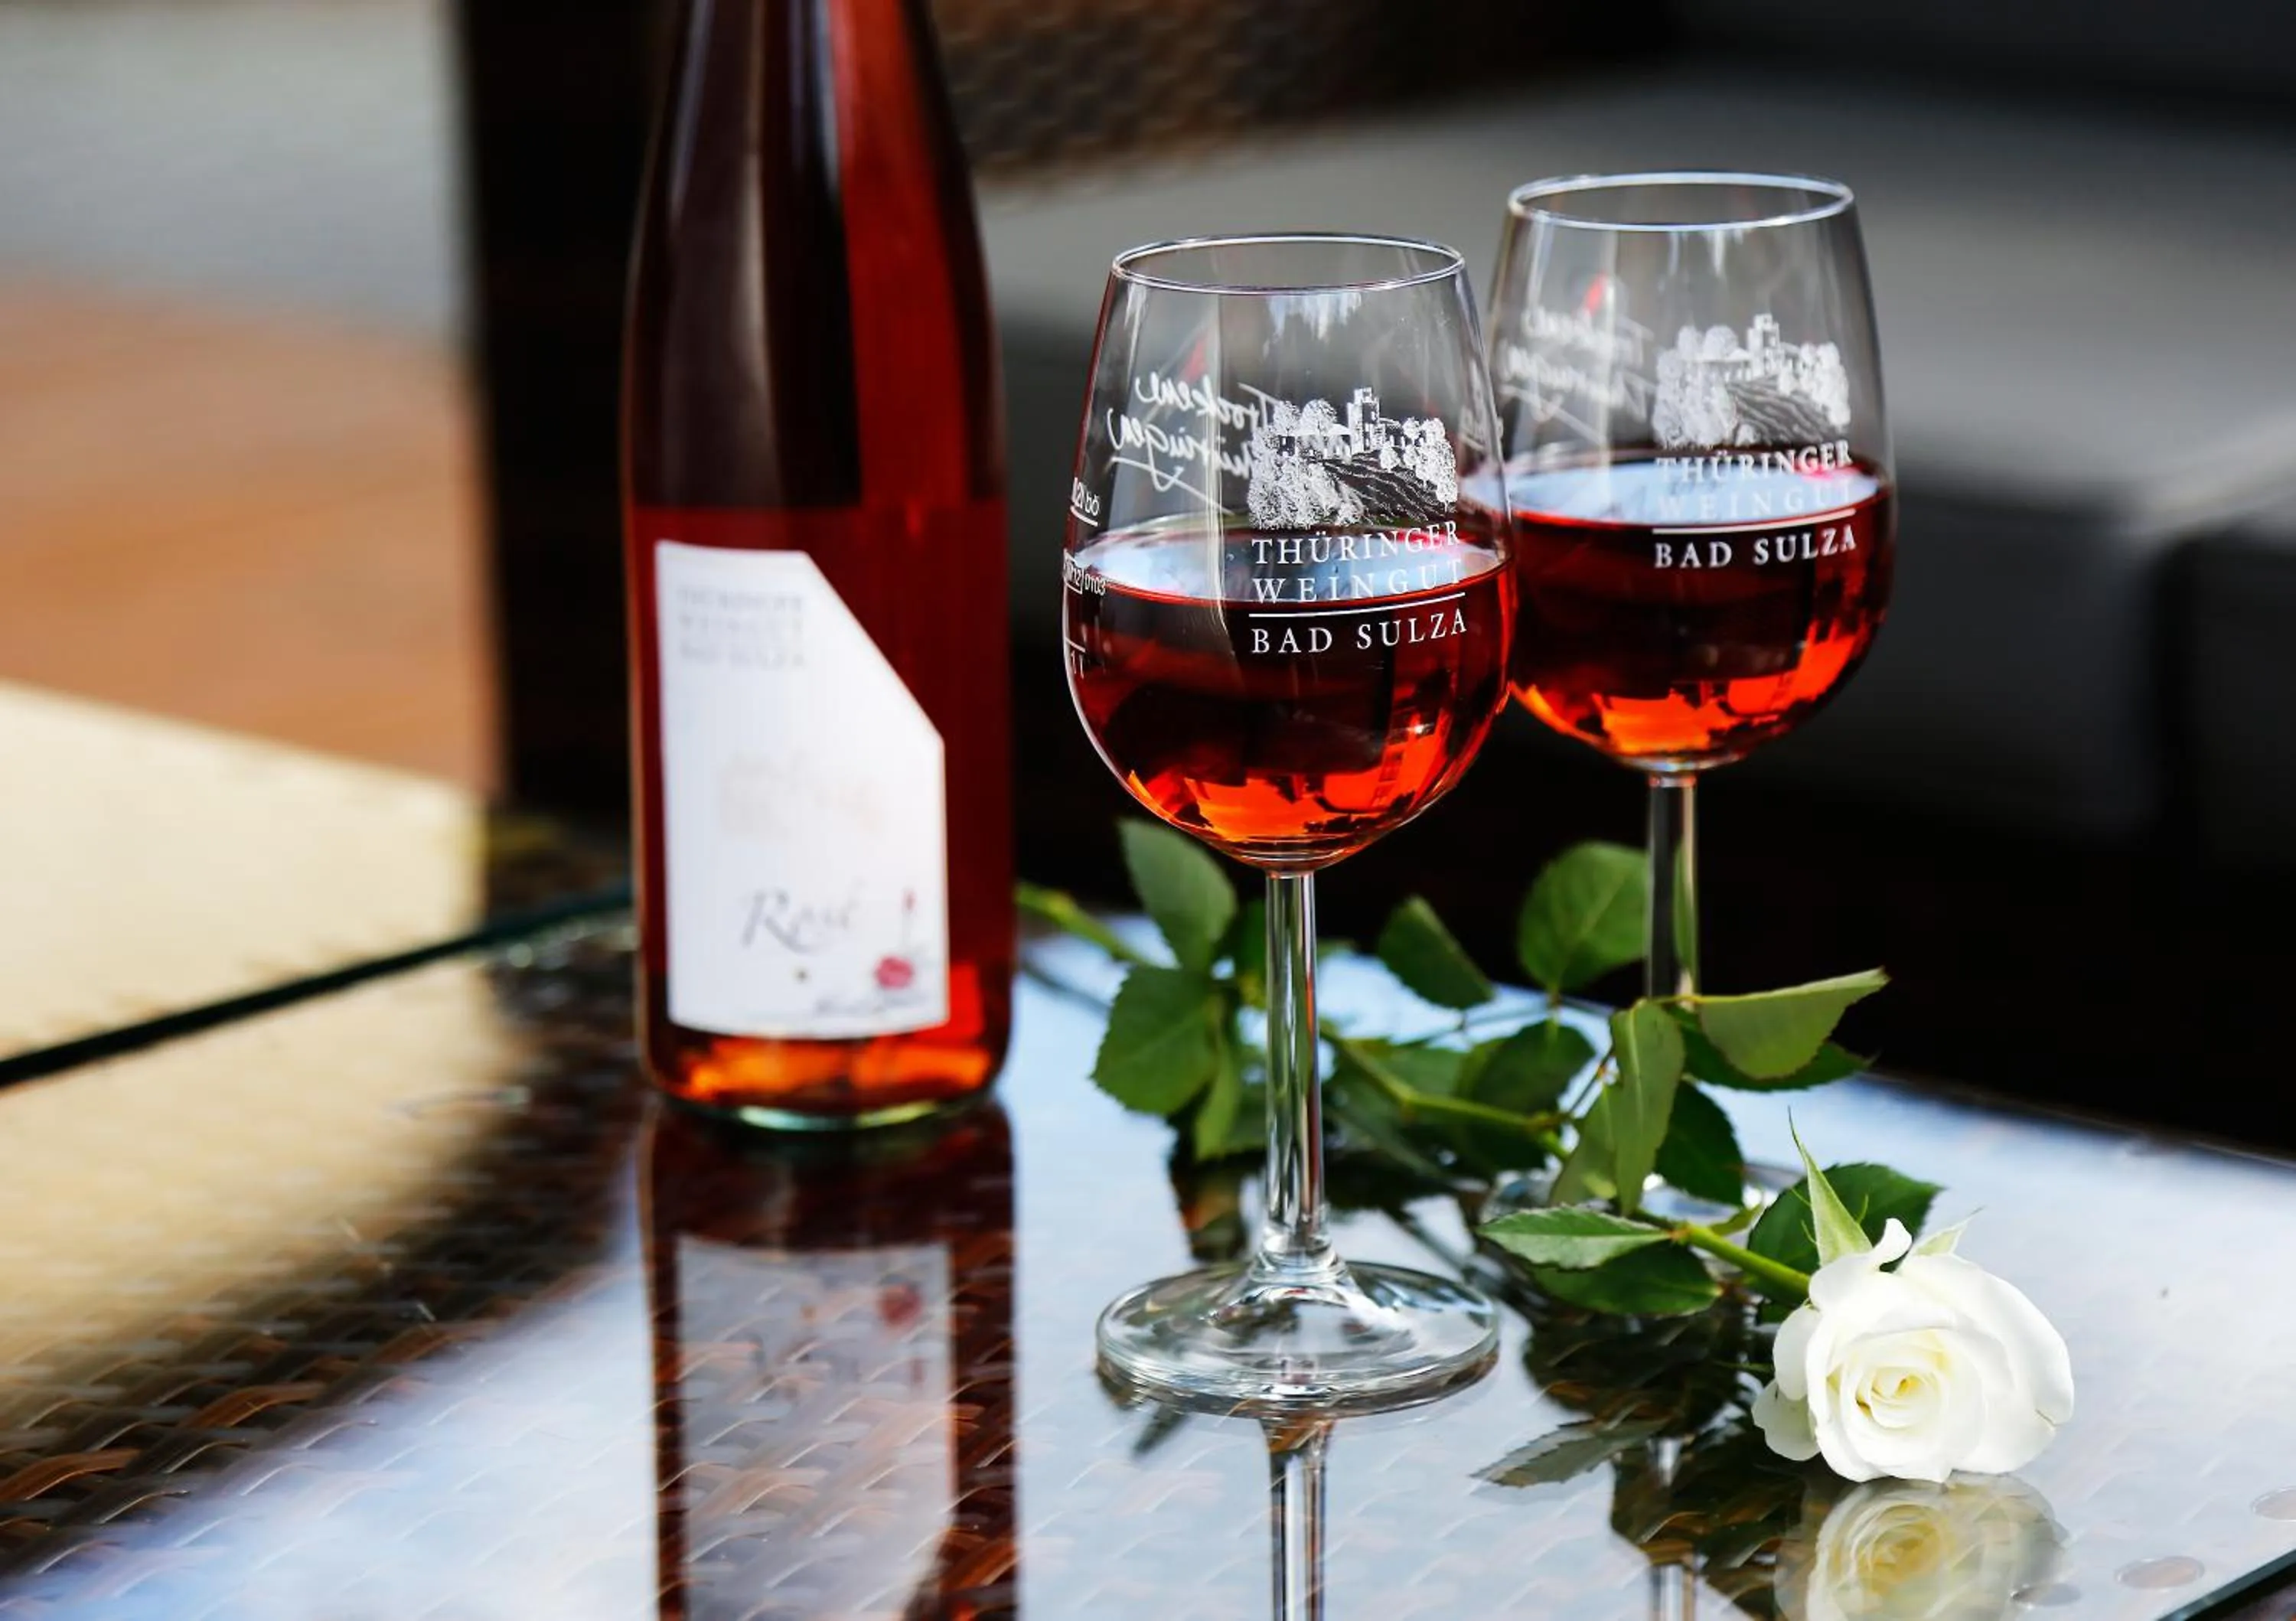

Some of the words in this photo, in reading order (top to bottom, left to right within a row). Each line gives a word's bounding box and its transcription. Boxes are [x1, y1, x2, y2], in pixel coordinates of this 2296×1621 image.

[1655, 439, 1853, 484] THÜRINGER
[1656, 478, 1851, 520] WEINGUT
[1251, 520, 1459, 564] THÜRINGER
[1654, 540, 1733, 569] BAD
[1754, 524, 1857, 565] SULZA
[1253, 559, 1462, 604] WEINGUT
[1251, 627, 1334, 654] BAD
[1357, 608, 1468, 650] SULZA
